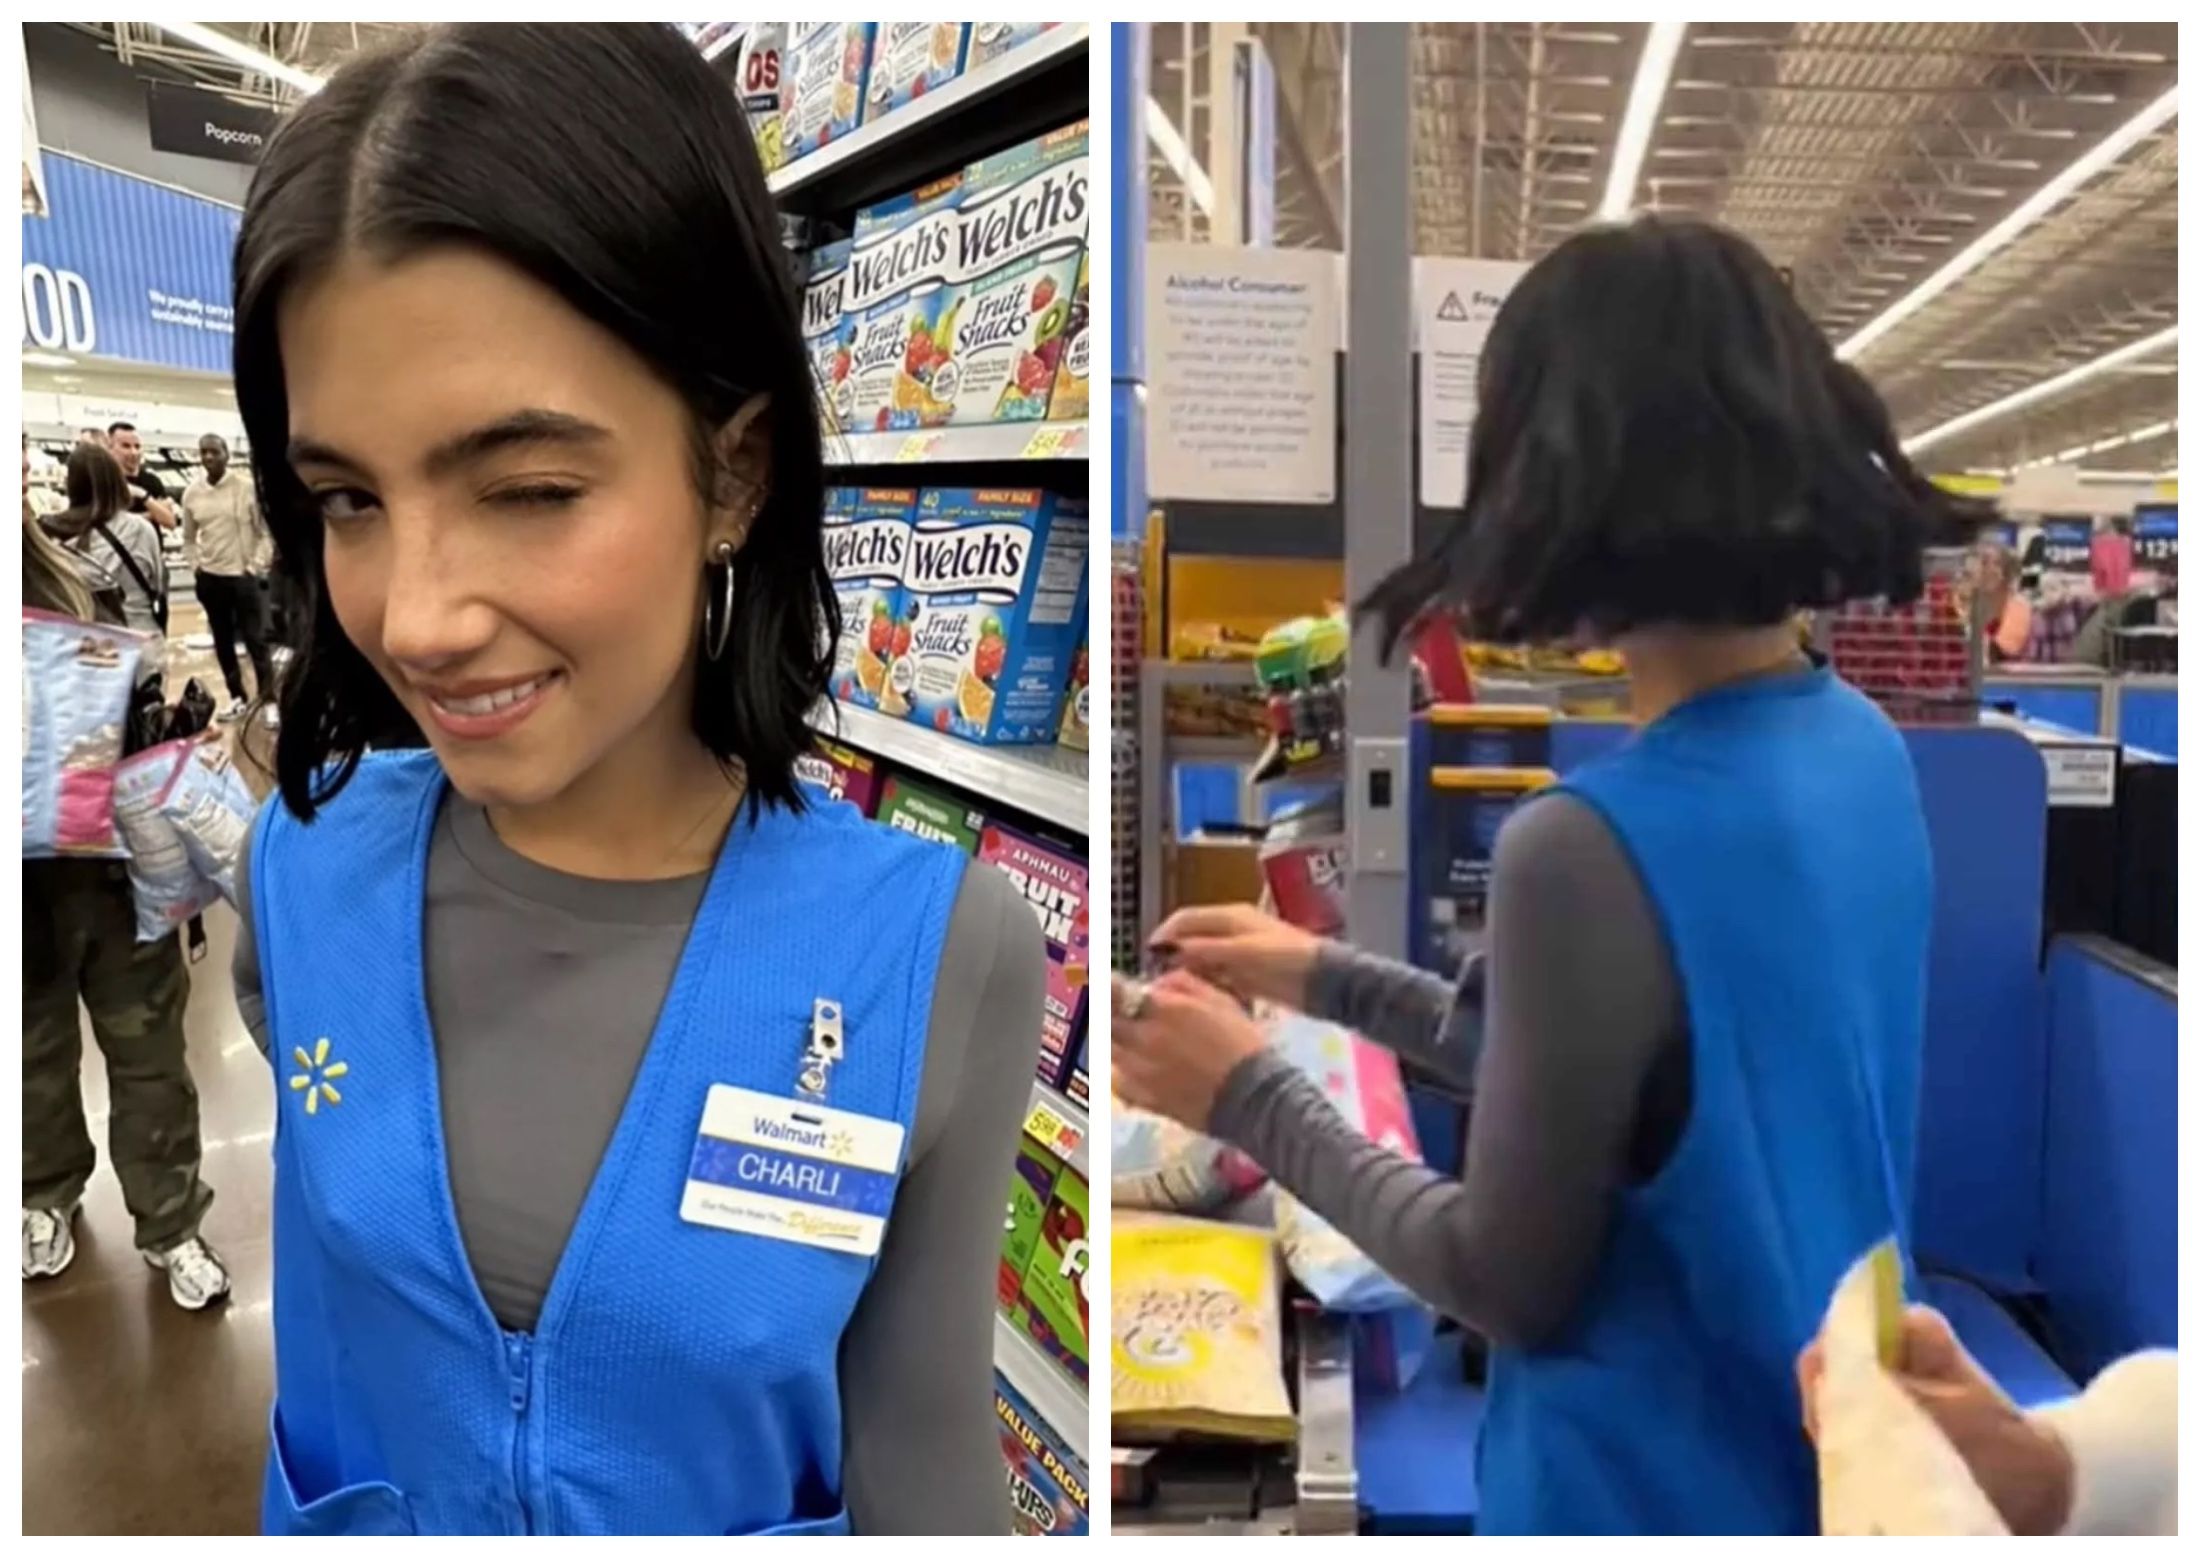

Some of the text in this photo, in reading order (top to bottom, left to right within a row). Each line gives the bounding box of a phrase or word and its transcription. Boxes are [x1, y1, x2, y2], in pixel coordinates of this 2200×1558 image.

[204, 122, 262, 144] Popcorn
[958, 169, 1088, 270] Welch's
[853, 219, 949, 299] Welch's
[1167, 275, 1223, 290] Alcohol
[22, 262, 96, 352] OD
[973, 283, 1026, 326] Fruit
[864, 314, 904, 349] Fruit
[954, 312, 1031, 356] Snacks
[853, 338, 908, 369] Snacks
[914, 532, 1023, 580] Welch's
[912, 627, 972, 657] Snacks
[926, 612, 968, 635] Fruit
[1012, 848, 1070, 882] APHMAU
[997, 860, 1081, 917] RUIT
[753, 1117, 827, 1149] Walmart
[737, 1152, 840, 1197] CHARLI
[996, 1396, 1042, 1455] VALUE
[1042, 1450, 1088, 1509] PACK
